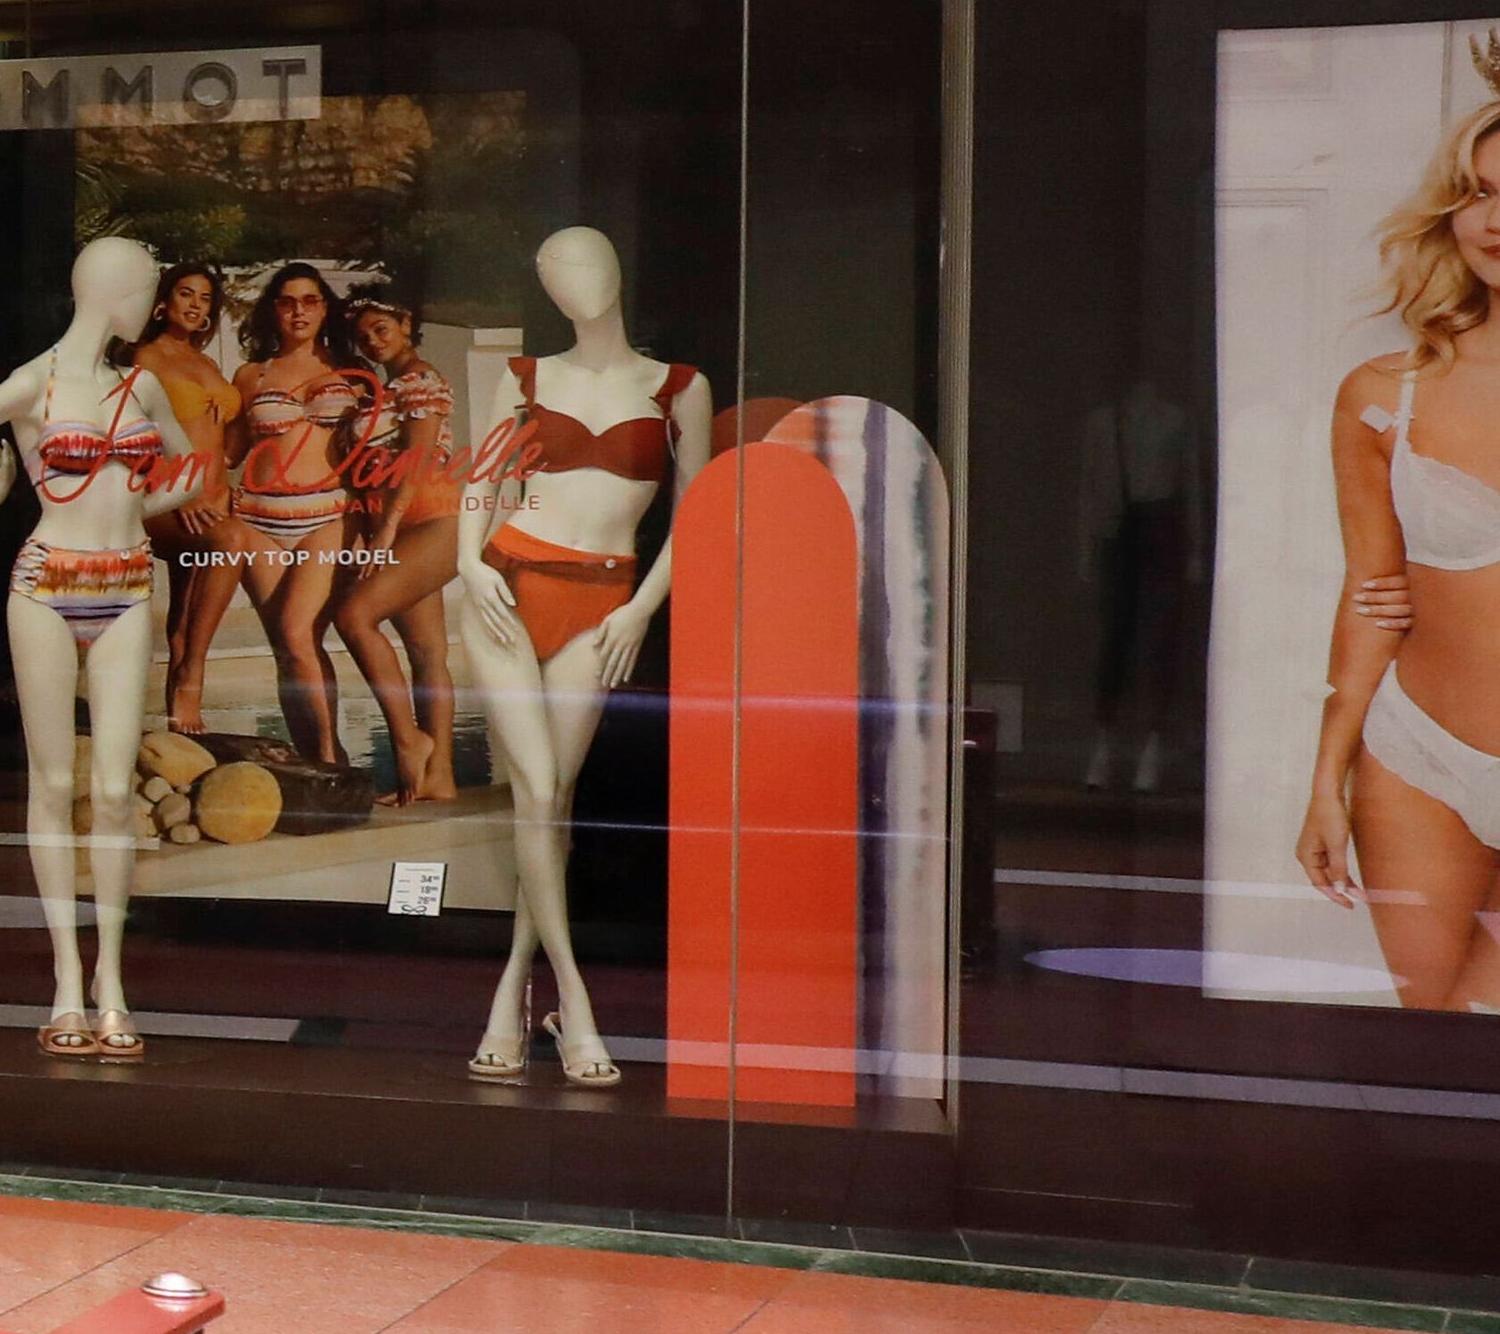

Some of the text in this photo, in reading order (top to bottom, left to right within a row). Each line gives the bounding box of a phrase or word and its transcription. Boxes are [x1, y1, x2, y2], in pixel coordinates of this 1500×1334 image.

[178, 548, 400, 568] CURVY TOP MODEL
